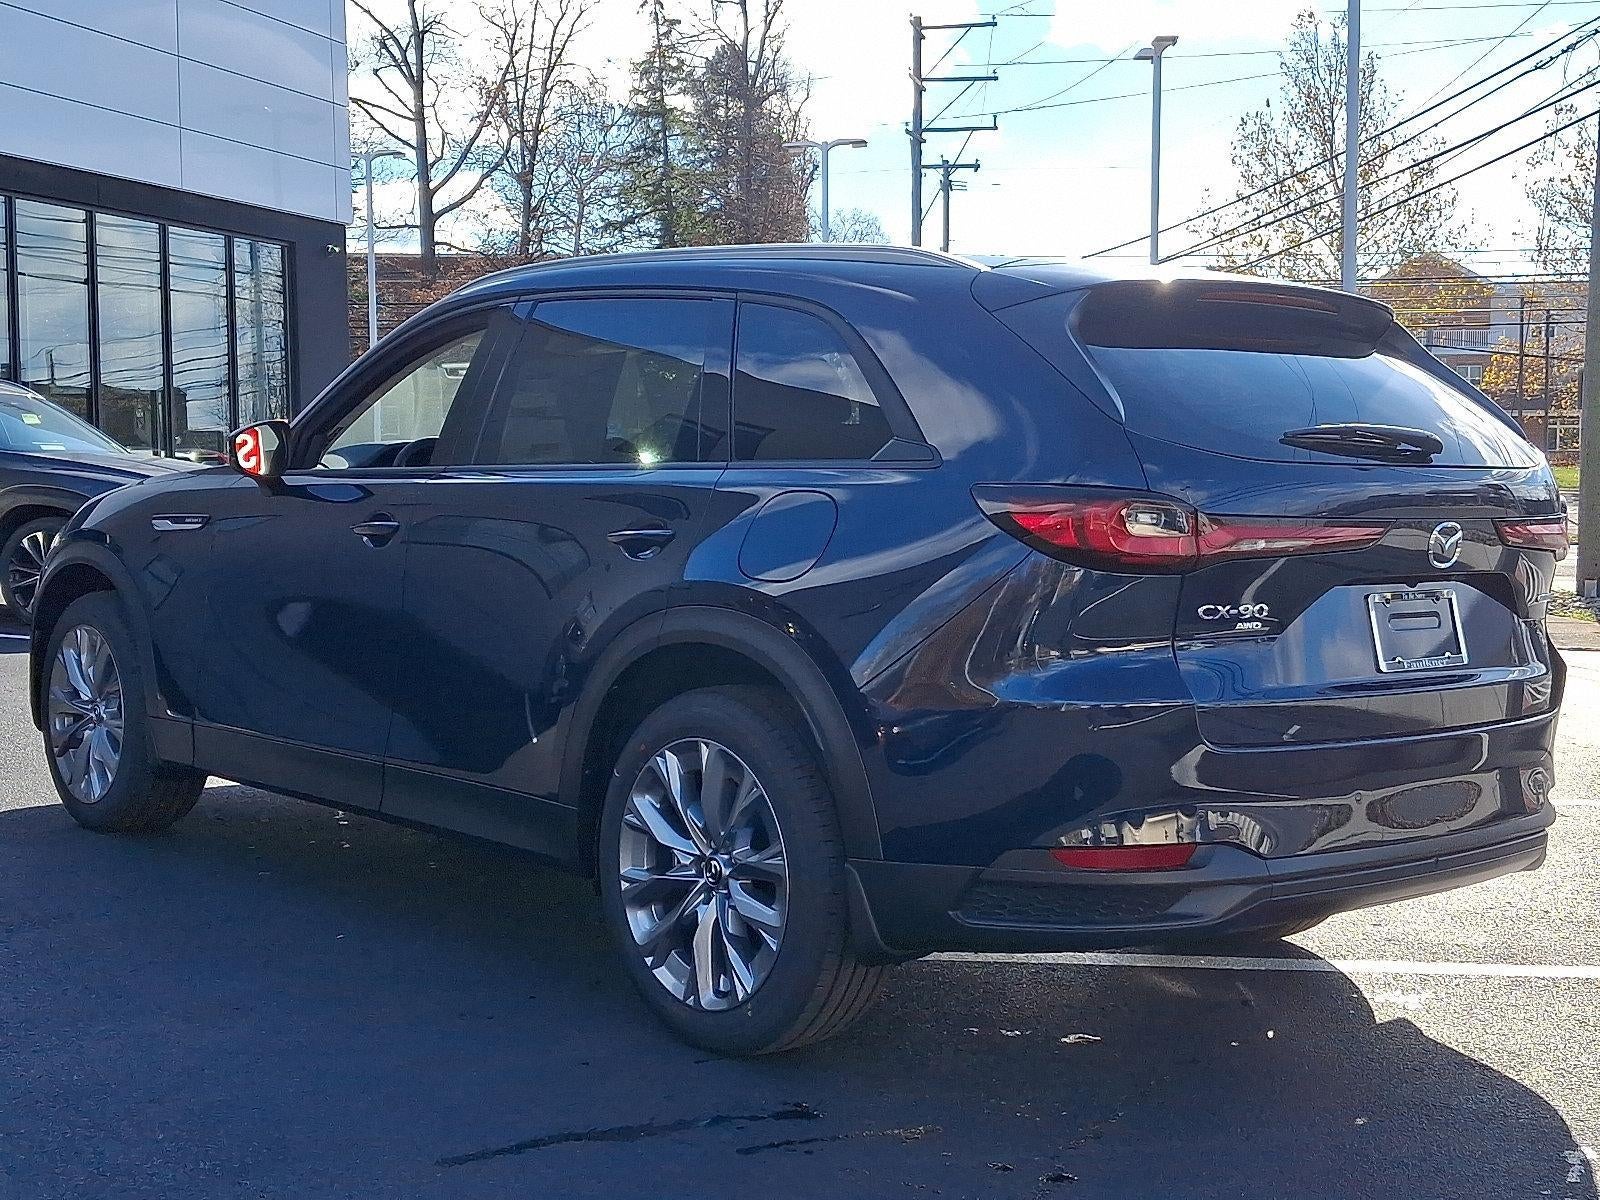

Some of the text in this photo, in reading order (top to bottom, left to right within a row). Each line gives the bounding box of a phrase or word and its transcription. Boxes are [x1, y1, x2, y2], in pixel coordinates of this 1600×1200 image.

[1197, 603, 1269, 620] CX-90
[1235, 621, 1262, 630] AWD
[1403, 658, 1447, 669] Faulkner
